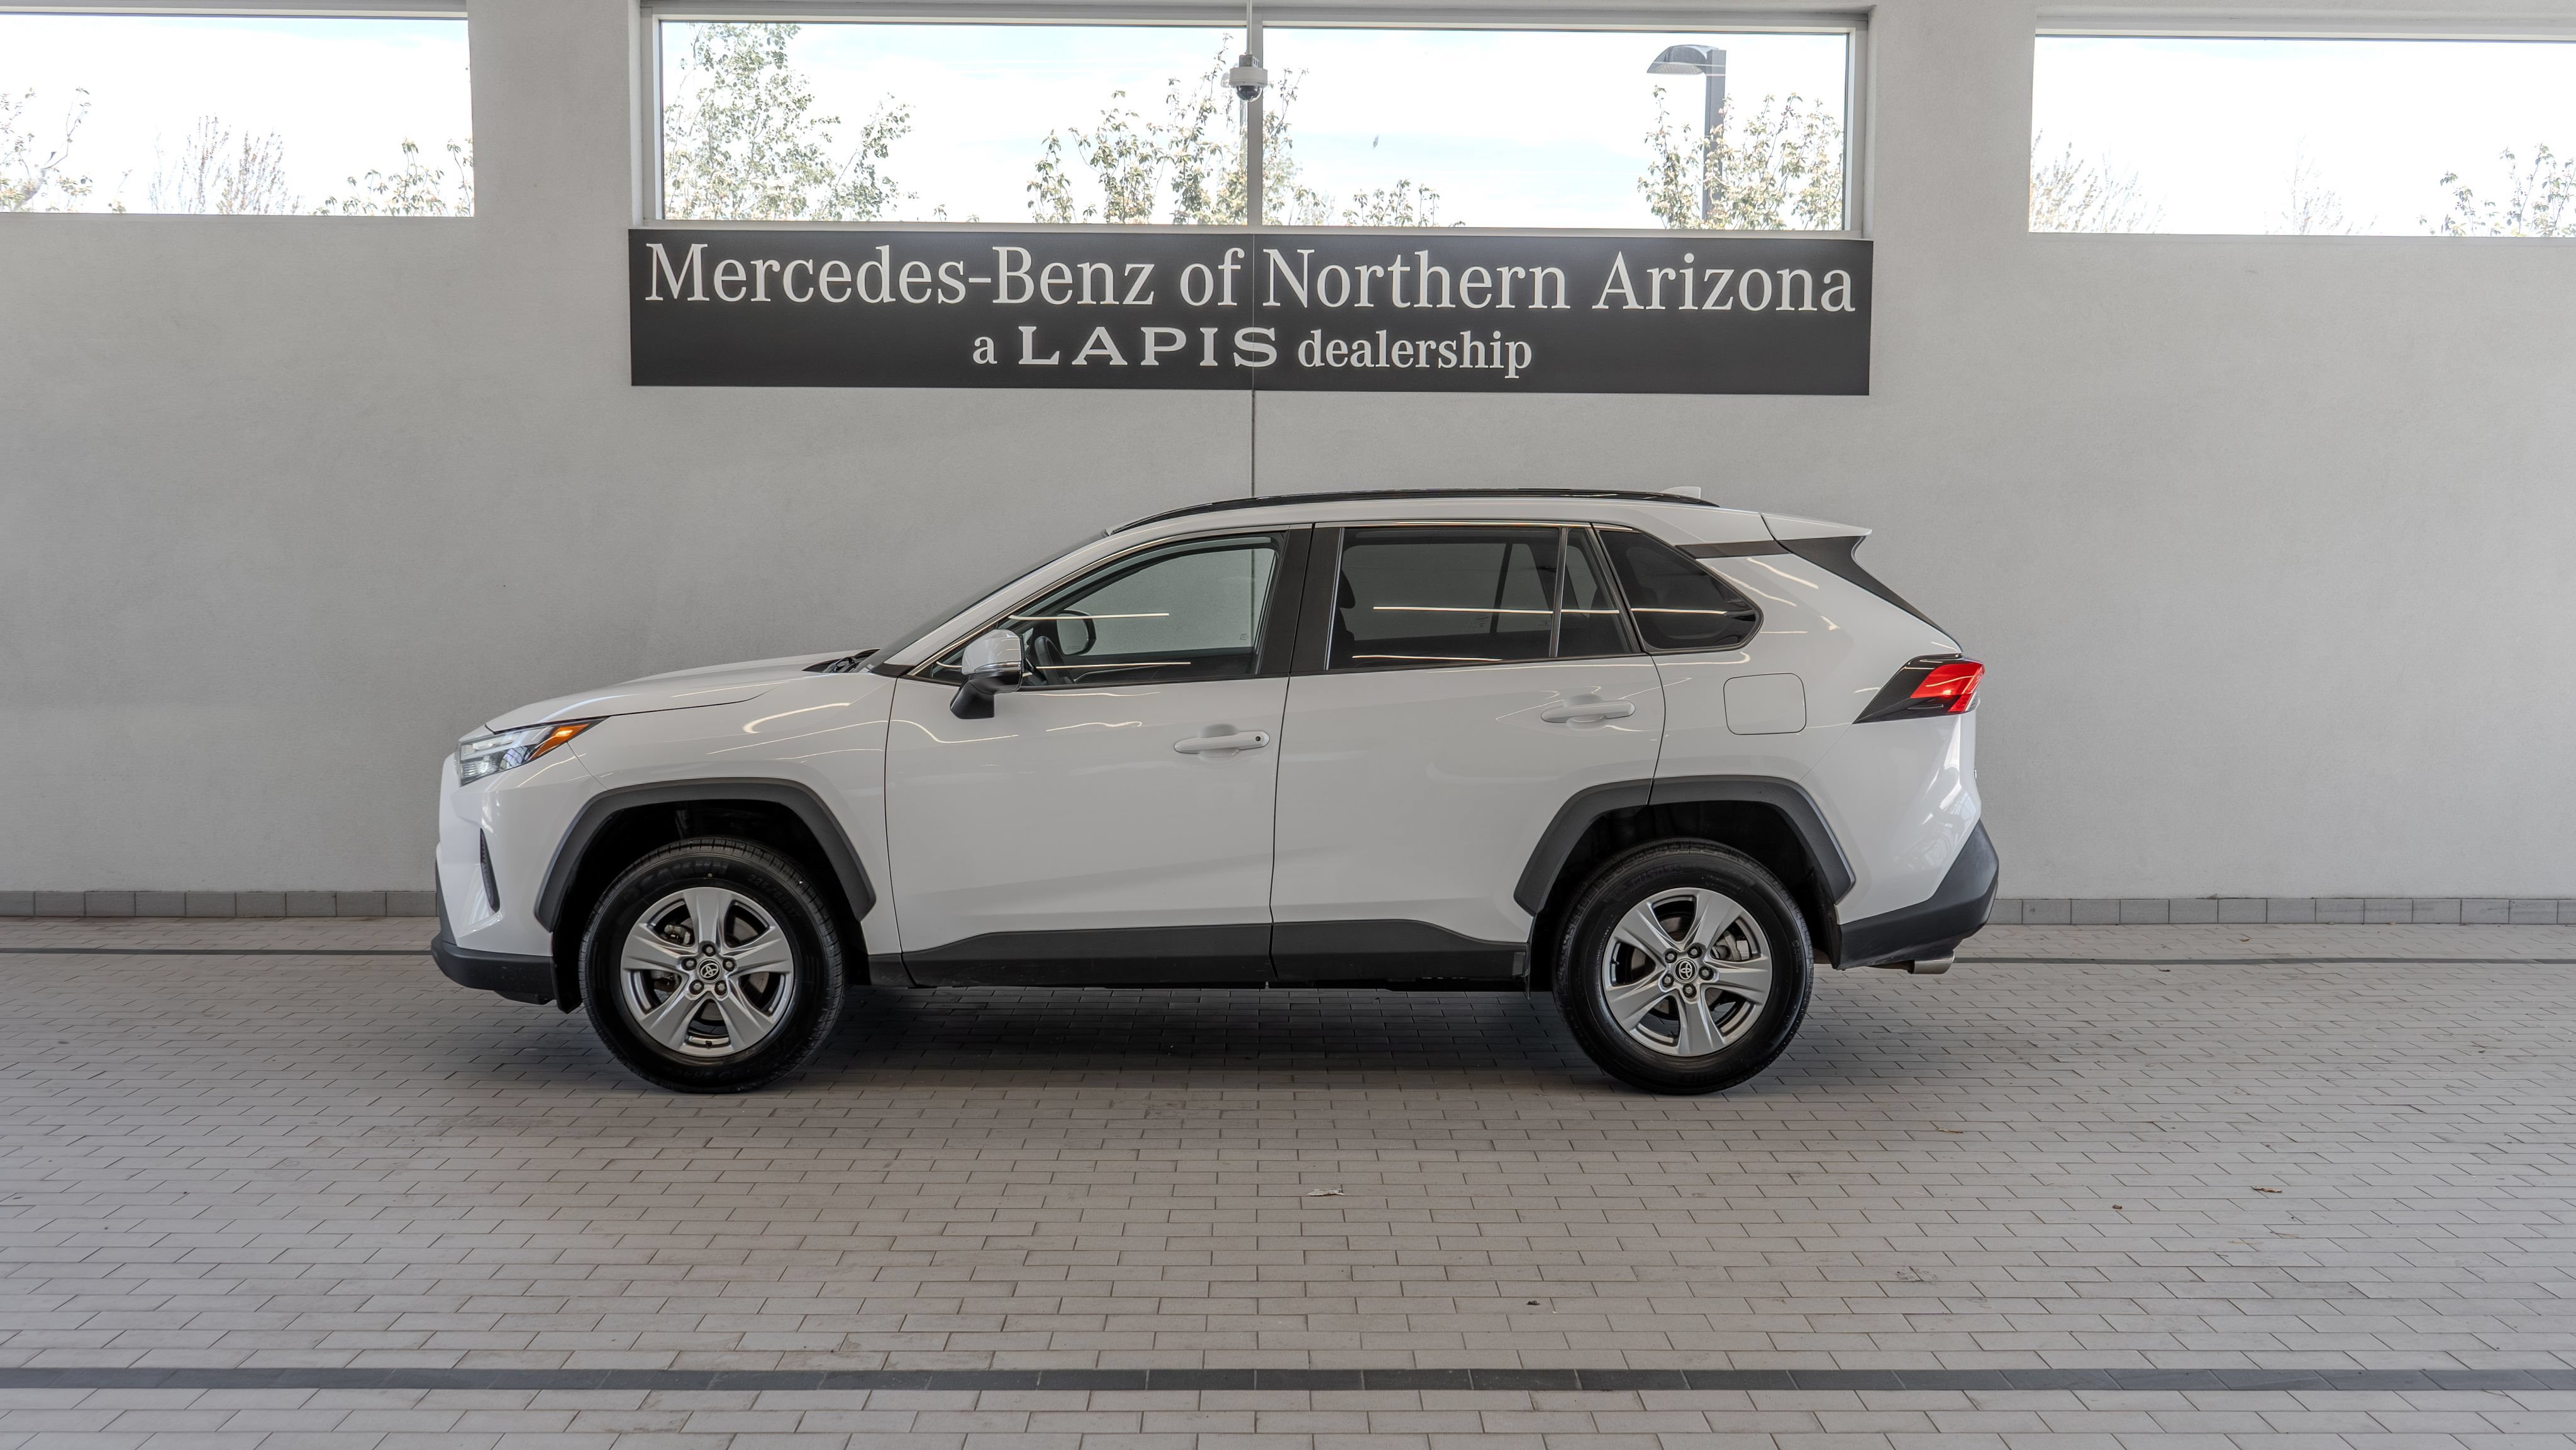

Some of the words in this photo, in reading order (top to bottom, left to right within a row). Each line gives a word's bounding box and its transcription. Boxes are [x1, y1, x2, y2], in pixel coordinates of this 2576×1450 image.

[645, 242, 1155, 305] Mercedes-Benz
[1179, 247, 1245, 306] of
[1262, 248, 1571, 310] Northern
[1592, 250, 1856, 312] Arizona
[972, 336, 998, 365] a
[1018, 325, 1277, 367] LAPIS
[1297, 328, 1532, 379] dealership
